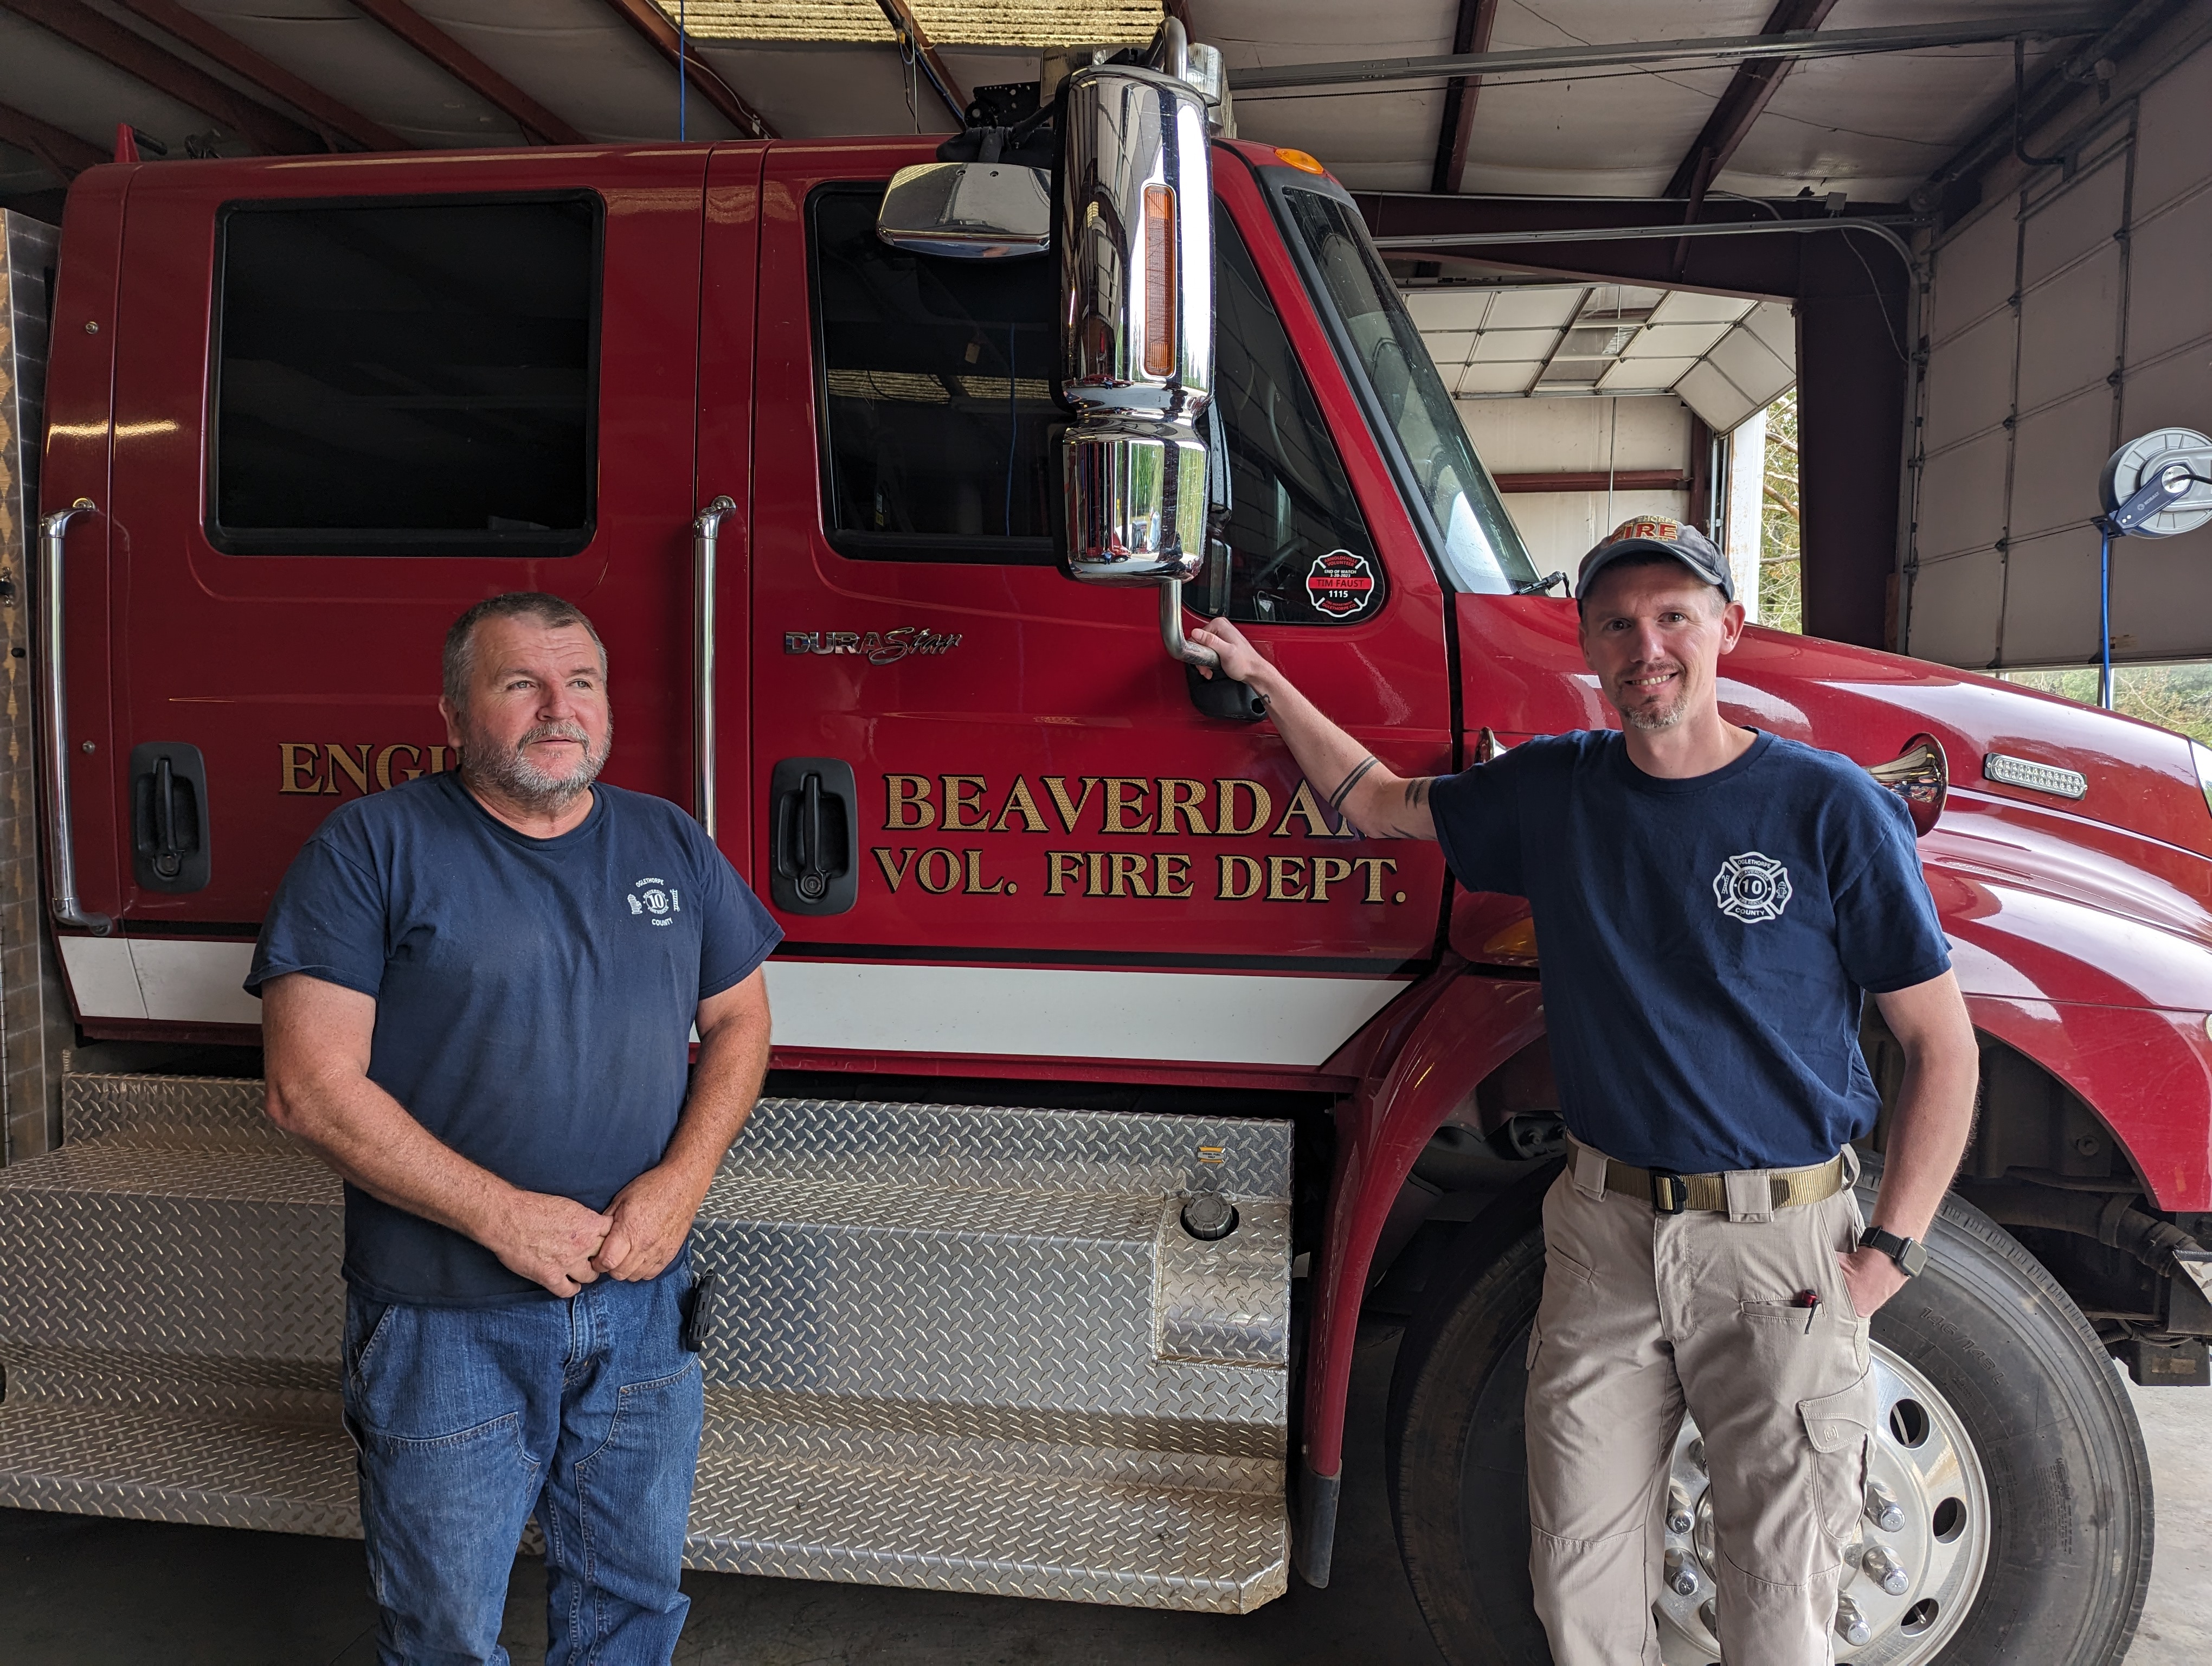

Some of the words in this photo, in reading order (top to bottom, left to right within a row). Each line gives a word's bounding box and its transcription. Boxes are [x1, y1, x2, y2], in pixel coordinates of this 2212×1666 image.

[1609, 522, 1678, 544] FIRE
[1322, 603, 1349, 611] OGLETHORPE
[881, 772, 1369, 839] BEAVERDA
[1738, 858, 1772, 869] OGLETHORPE
[870, 847, 1018, 895] VOL.
[1044, 850, 1195, 899] FIRE
[1214, 854, 1406, 905] DEPT.
[1738, 869, 1769, 882] BEAVERDAM
[635, 877, 664, 888] OGLETHORPE
[1742, 879, 1762, 895] 10
[647, 894, 664, 908] 10
[1735, 907, 1765, 916] COUNTY
[652, 917, 673, 926] COUNTY
